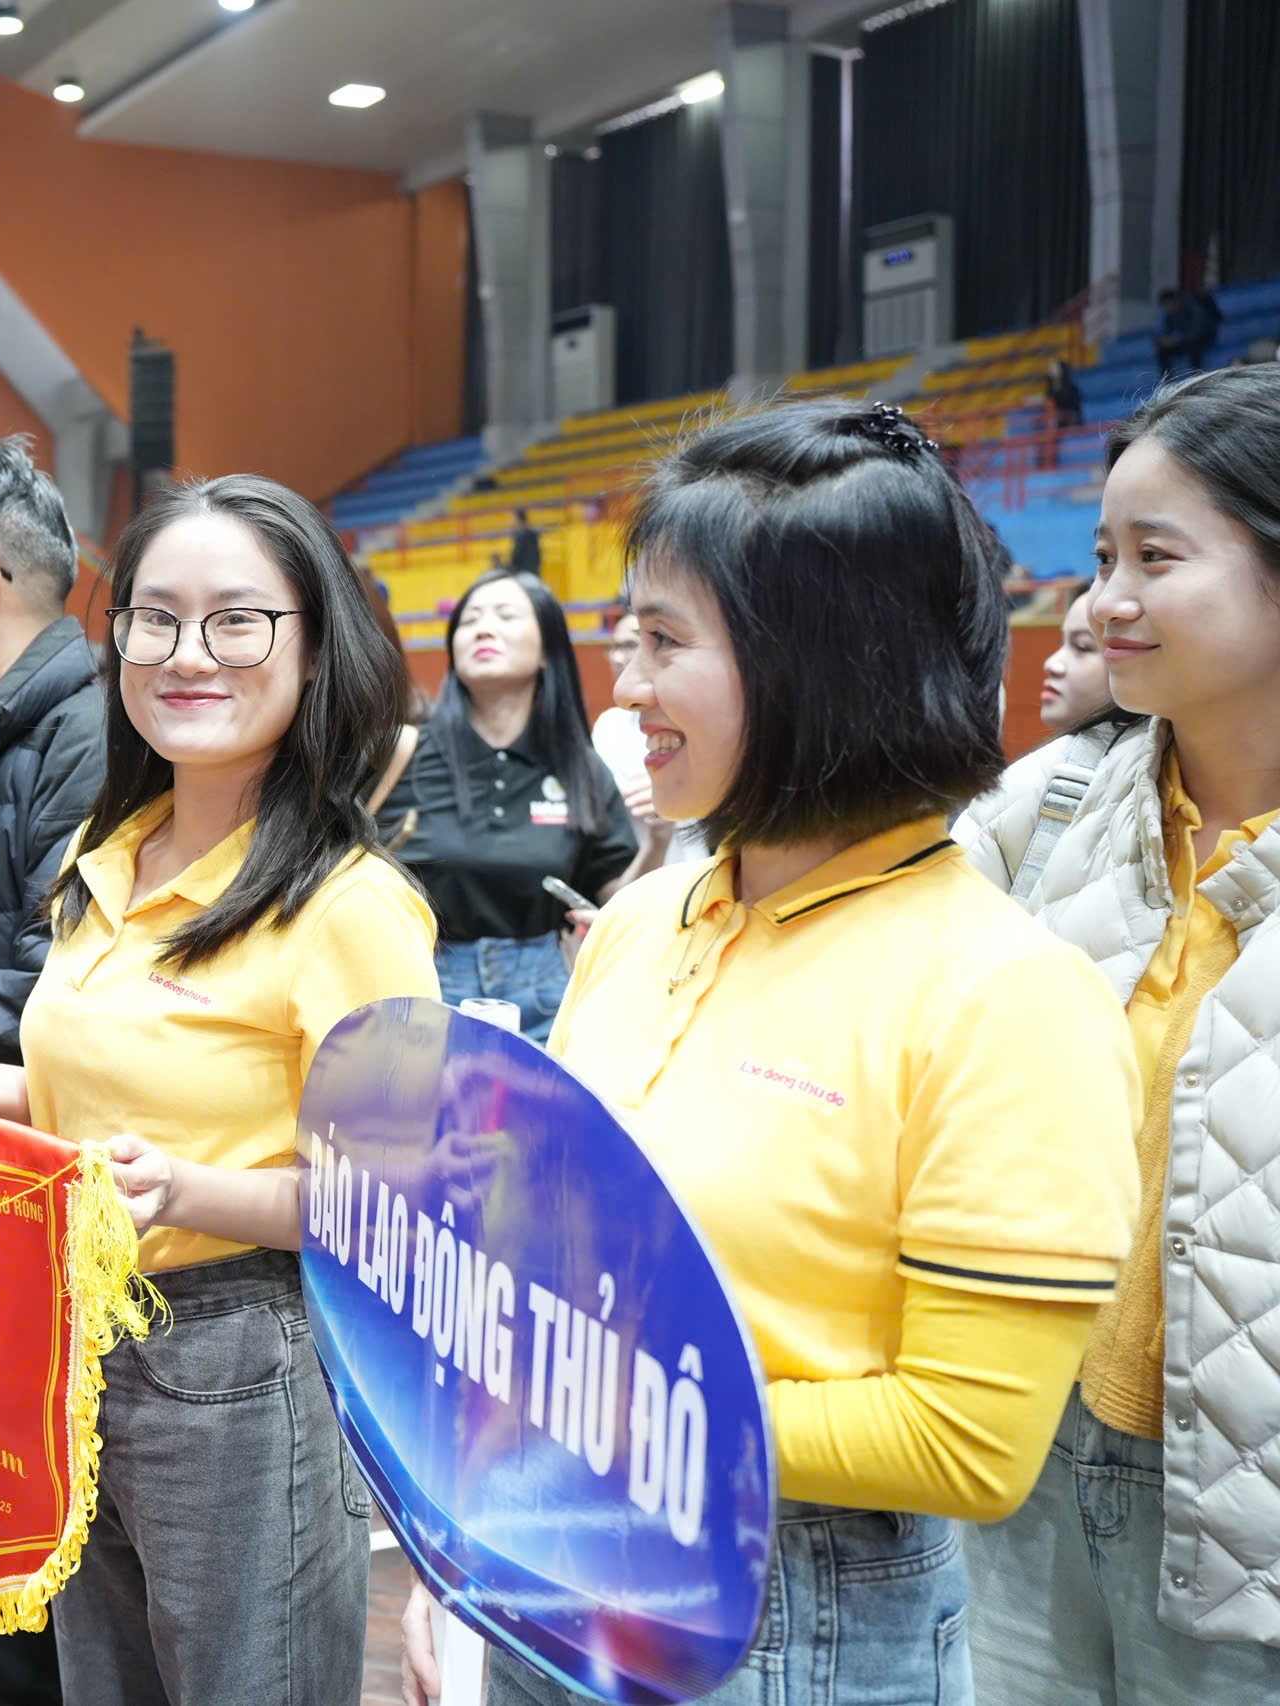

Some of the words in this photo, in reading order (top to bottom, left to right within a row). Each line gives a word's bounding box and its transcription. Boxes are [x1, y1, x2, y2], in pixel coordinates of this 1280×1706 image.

[13, 1196, 44, 1224] RỘNG
[309, 1121, 353, 1266] BÁO
[358, 1169, 409, 1315] LAO
[412, 1200, 516, 1405] ĐỘNG
[528, 1272, 620, 1477] THỦ
[629, 1343, 708, 1547] ĐÔ
